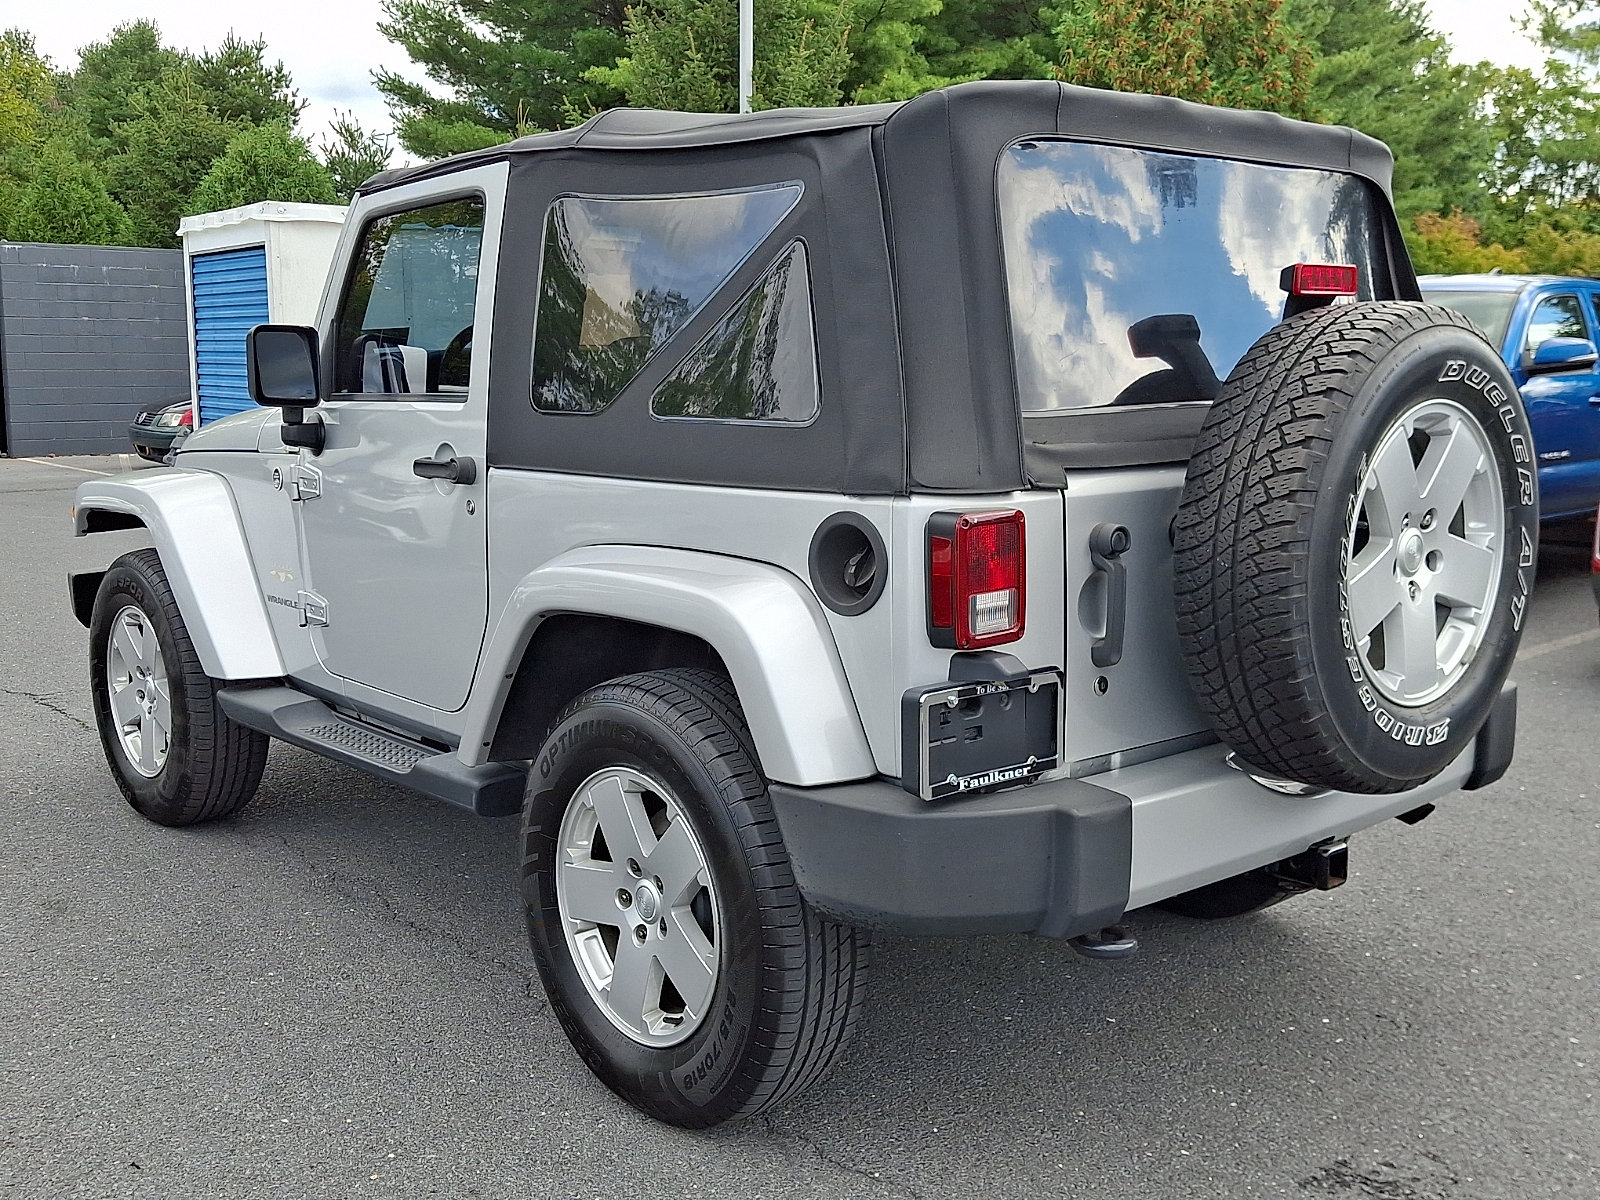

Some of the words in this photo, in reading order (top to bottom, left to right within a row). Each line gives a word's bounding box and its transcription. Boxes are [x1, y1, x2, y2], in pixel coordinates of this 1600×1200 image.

[1438, 360, 1534, 506] DUELER
[1511, 525, 1534, 632] A/T
[266, 594, 299, 608] WRANGLE
[975, 685, 986, 695] To
[957, 766, 1032, 791] Faulkner
